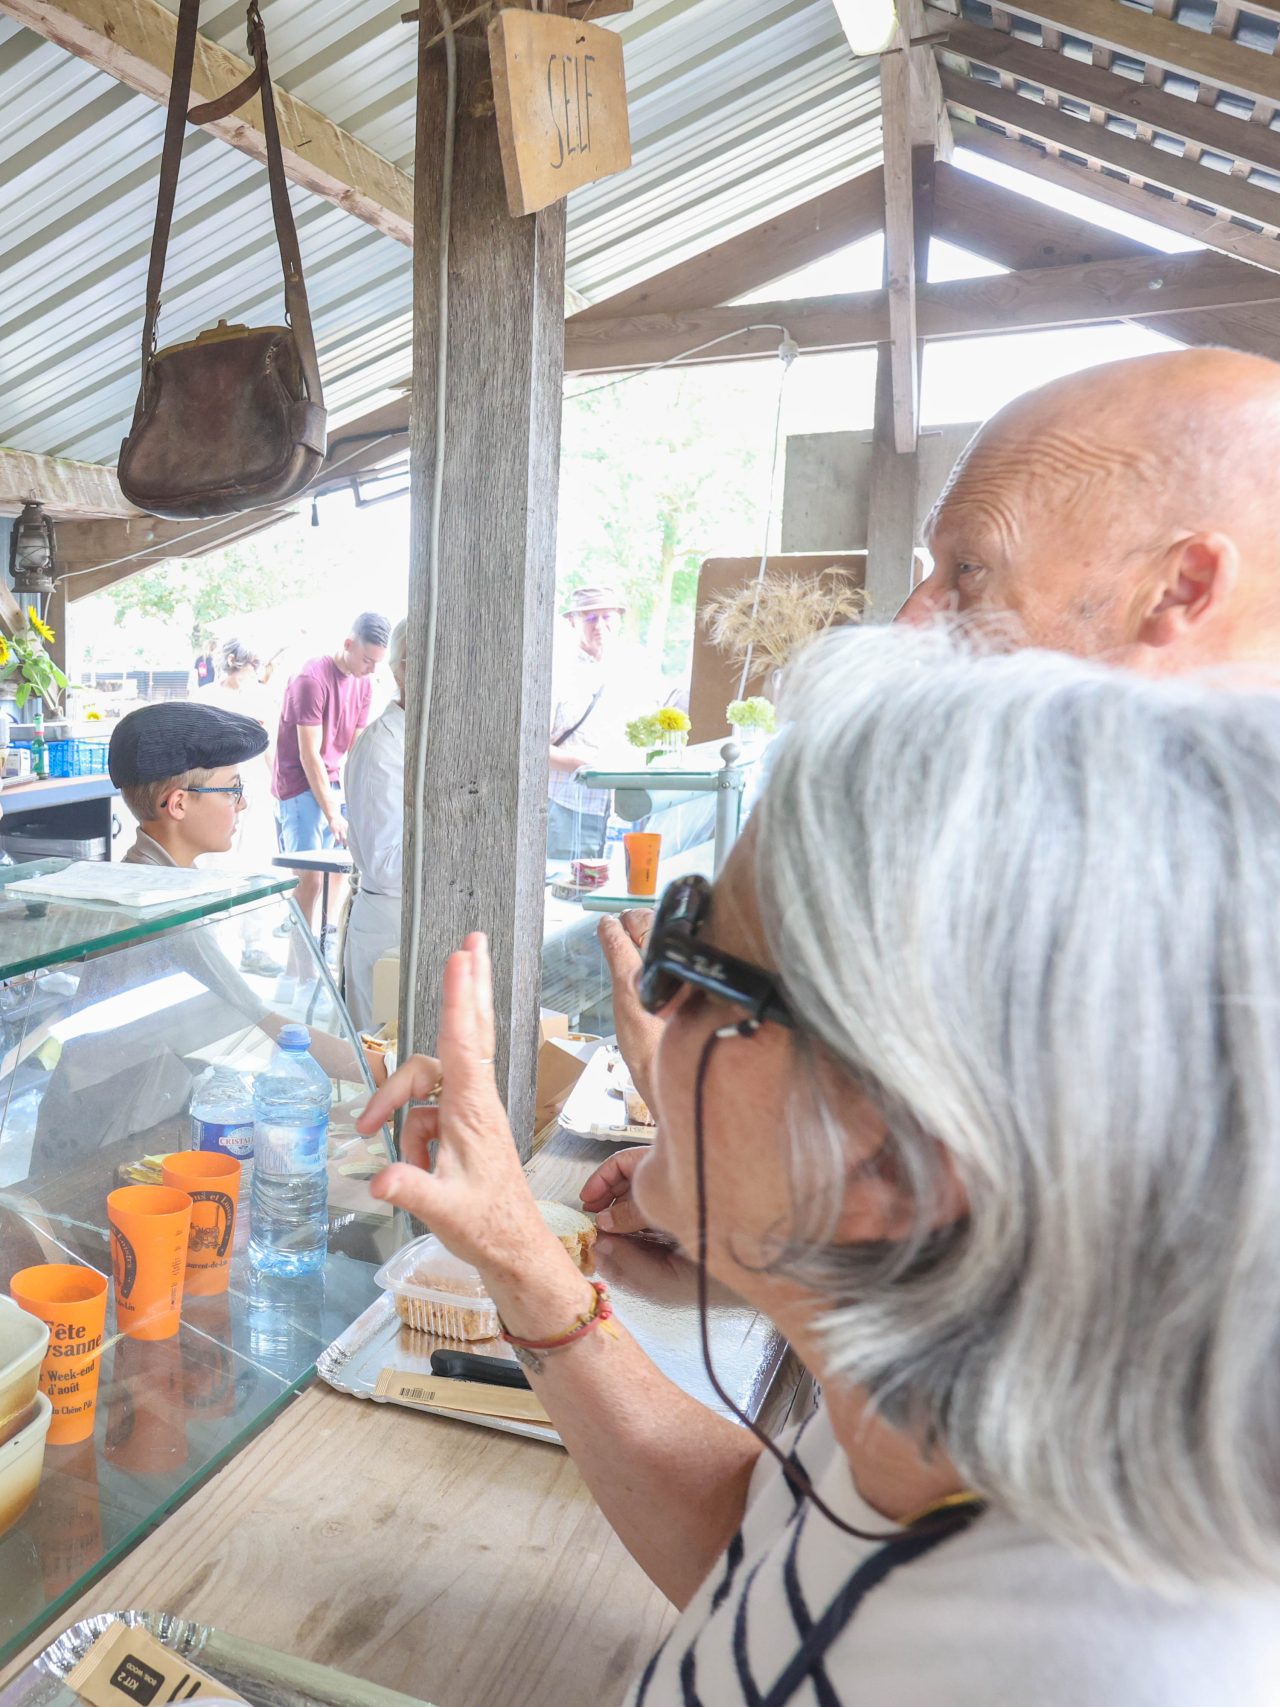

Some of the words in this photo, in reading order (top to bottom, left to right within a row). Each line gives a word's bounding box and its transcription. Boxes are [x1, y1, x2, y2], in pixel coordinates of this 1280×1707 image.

[547, 53, 596, 169] SELF
[47, 1359, 95, 1382] Week-end
[117, 1671, 127, 1682] 2
[126, 1662, 144, 1677] WOOD
[122, 1676, 140, 1691] KIT
